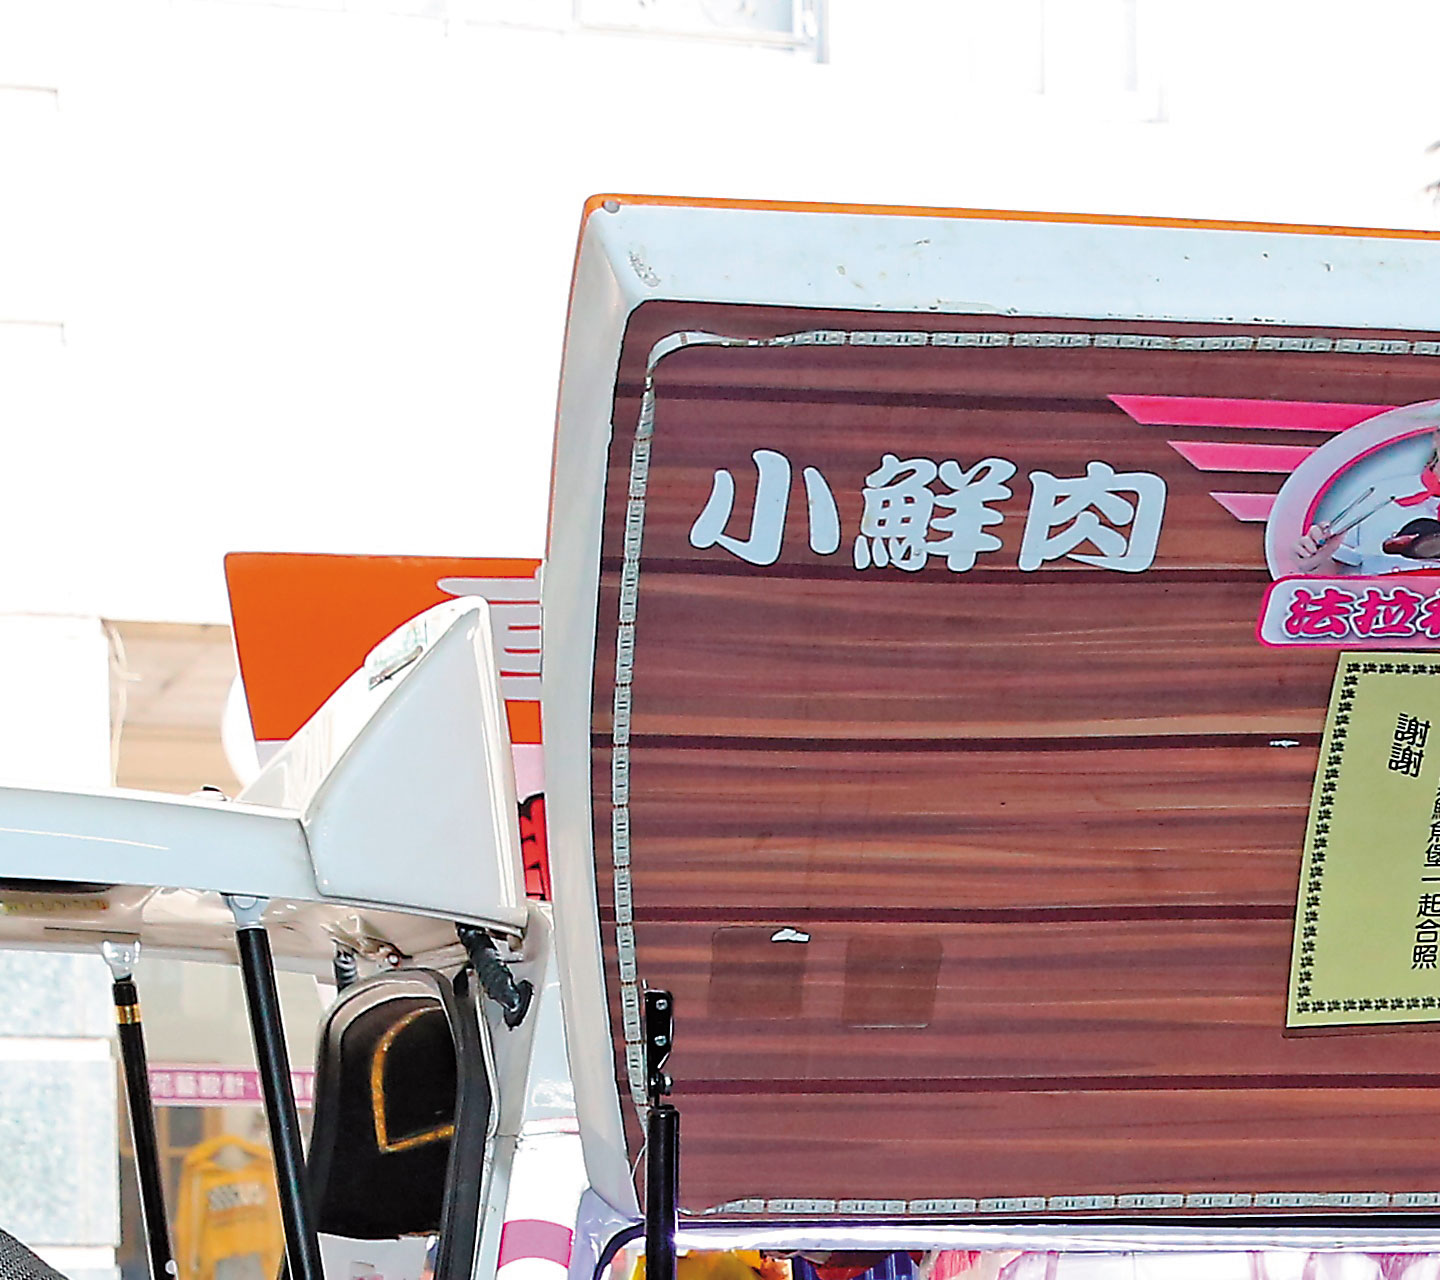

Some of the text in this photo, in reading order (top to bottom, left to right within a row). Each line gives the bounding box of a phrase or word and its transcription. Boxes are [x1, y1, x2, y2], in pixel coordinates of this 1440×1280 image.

[689, 448, 1166, 574] 小鮮肉
[1388, 713, 1431, 778] 謝謝
